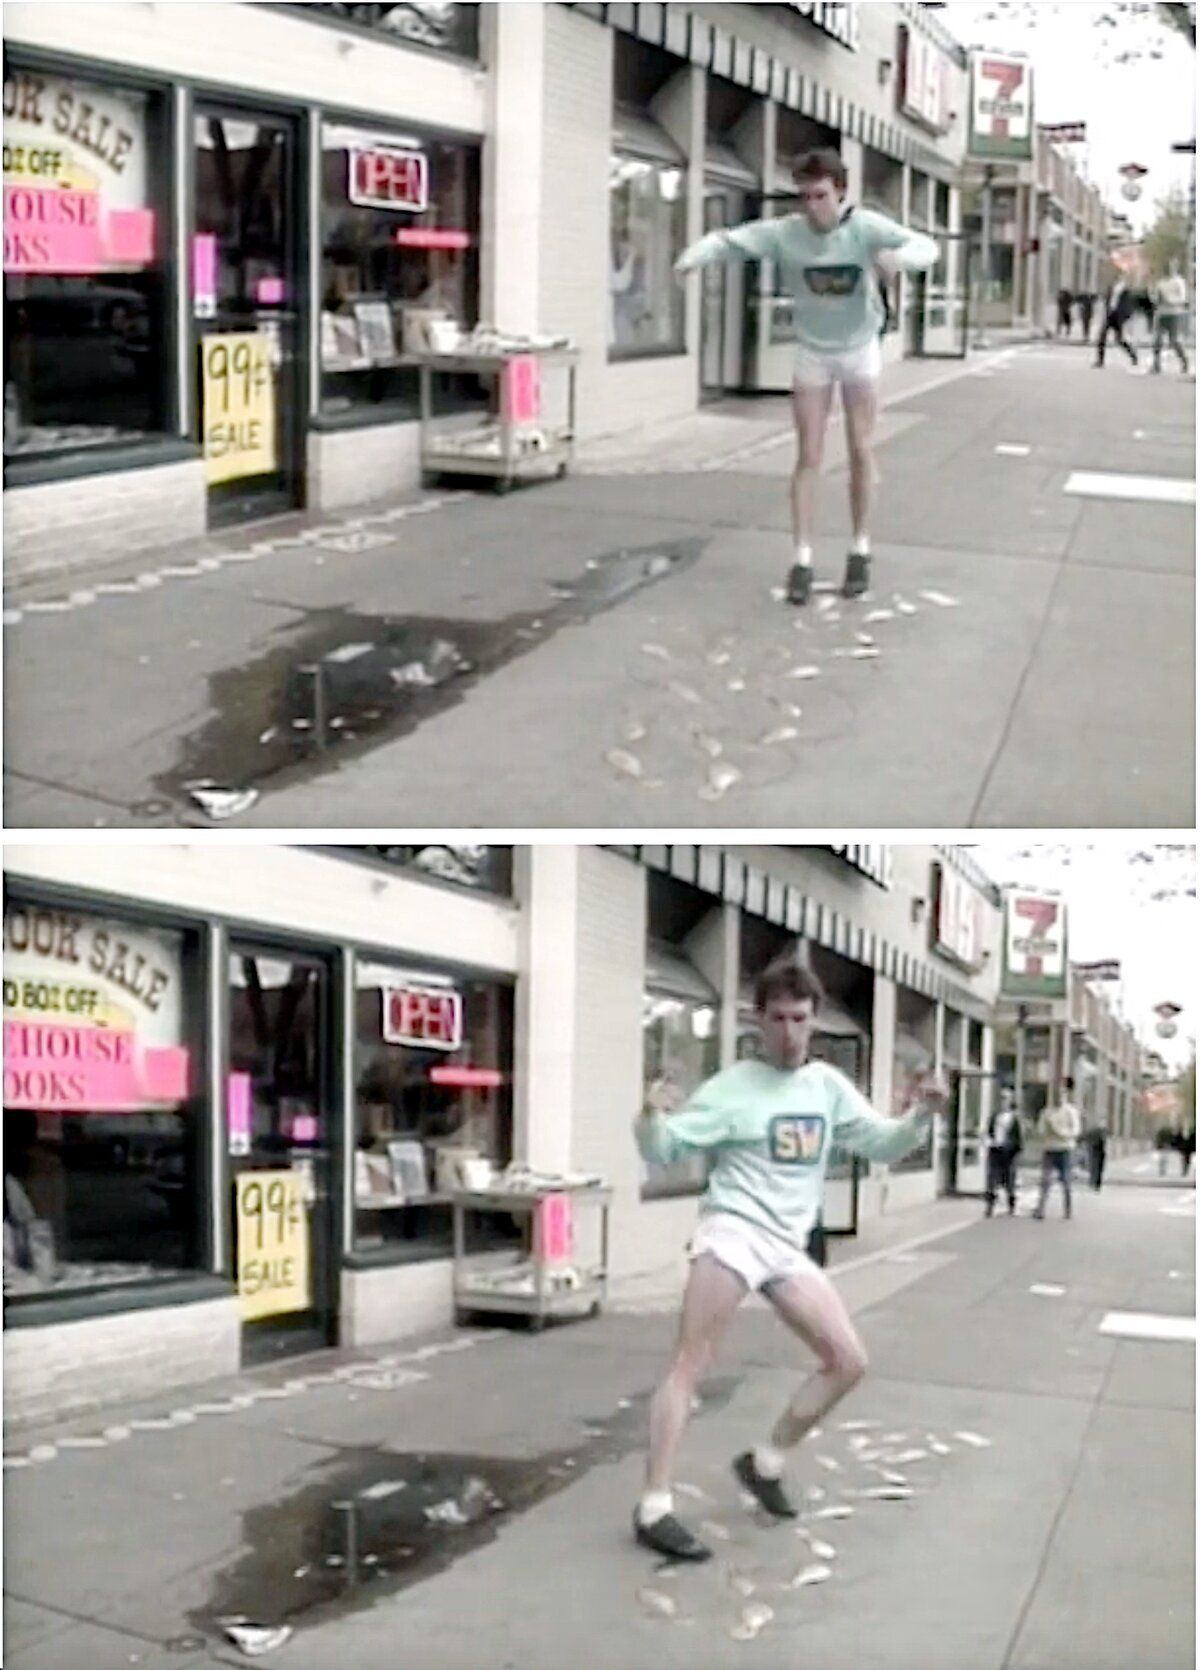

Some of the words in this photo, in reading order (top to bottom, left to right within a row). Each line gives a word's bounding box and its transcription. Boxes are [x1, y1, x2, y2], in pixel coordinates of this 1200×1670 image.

[54, 93, 134, 174] SALE
[29, 151, 62, 175] OFF
[355, 151, 421, 204] OPEN
[209, 418, 261, 458] SALE
[90, 928, 169, 1012] SALE
[64, 987, 98, 1014] OFF
[388, 988, 456, 1042] OPEN
[243, 1257, 295, 1294] SALE
